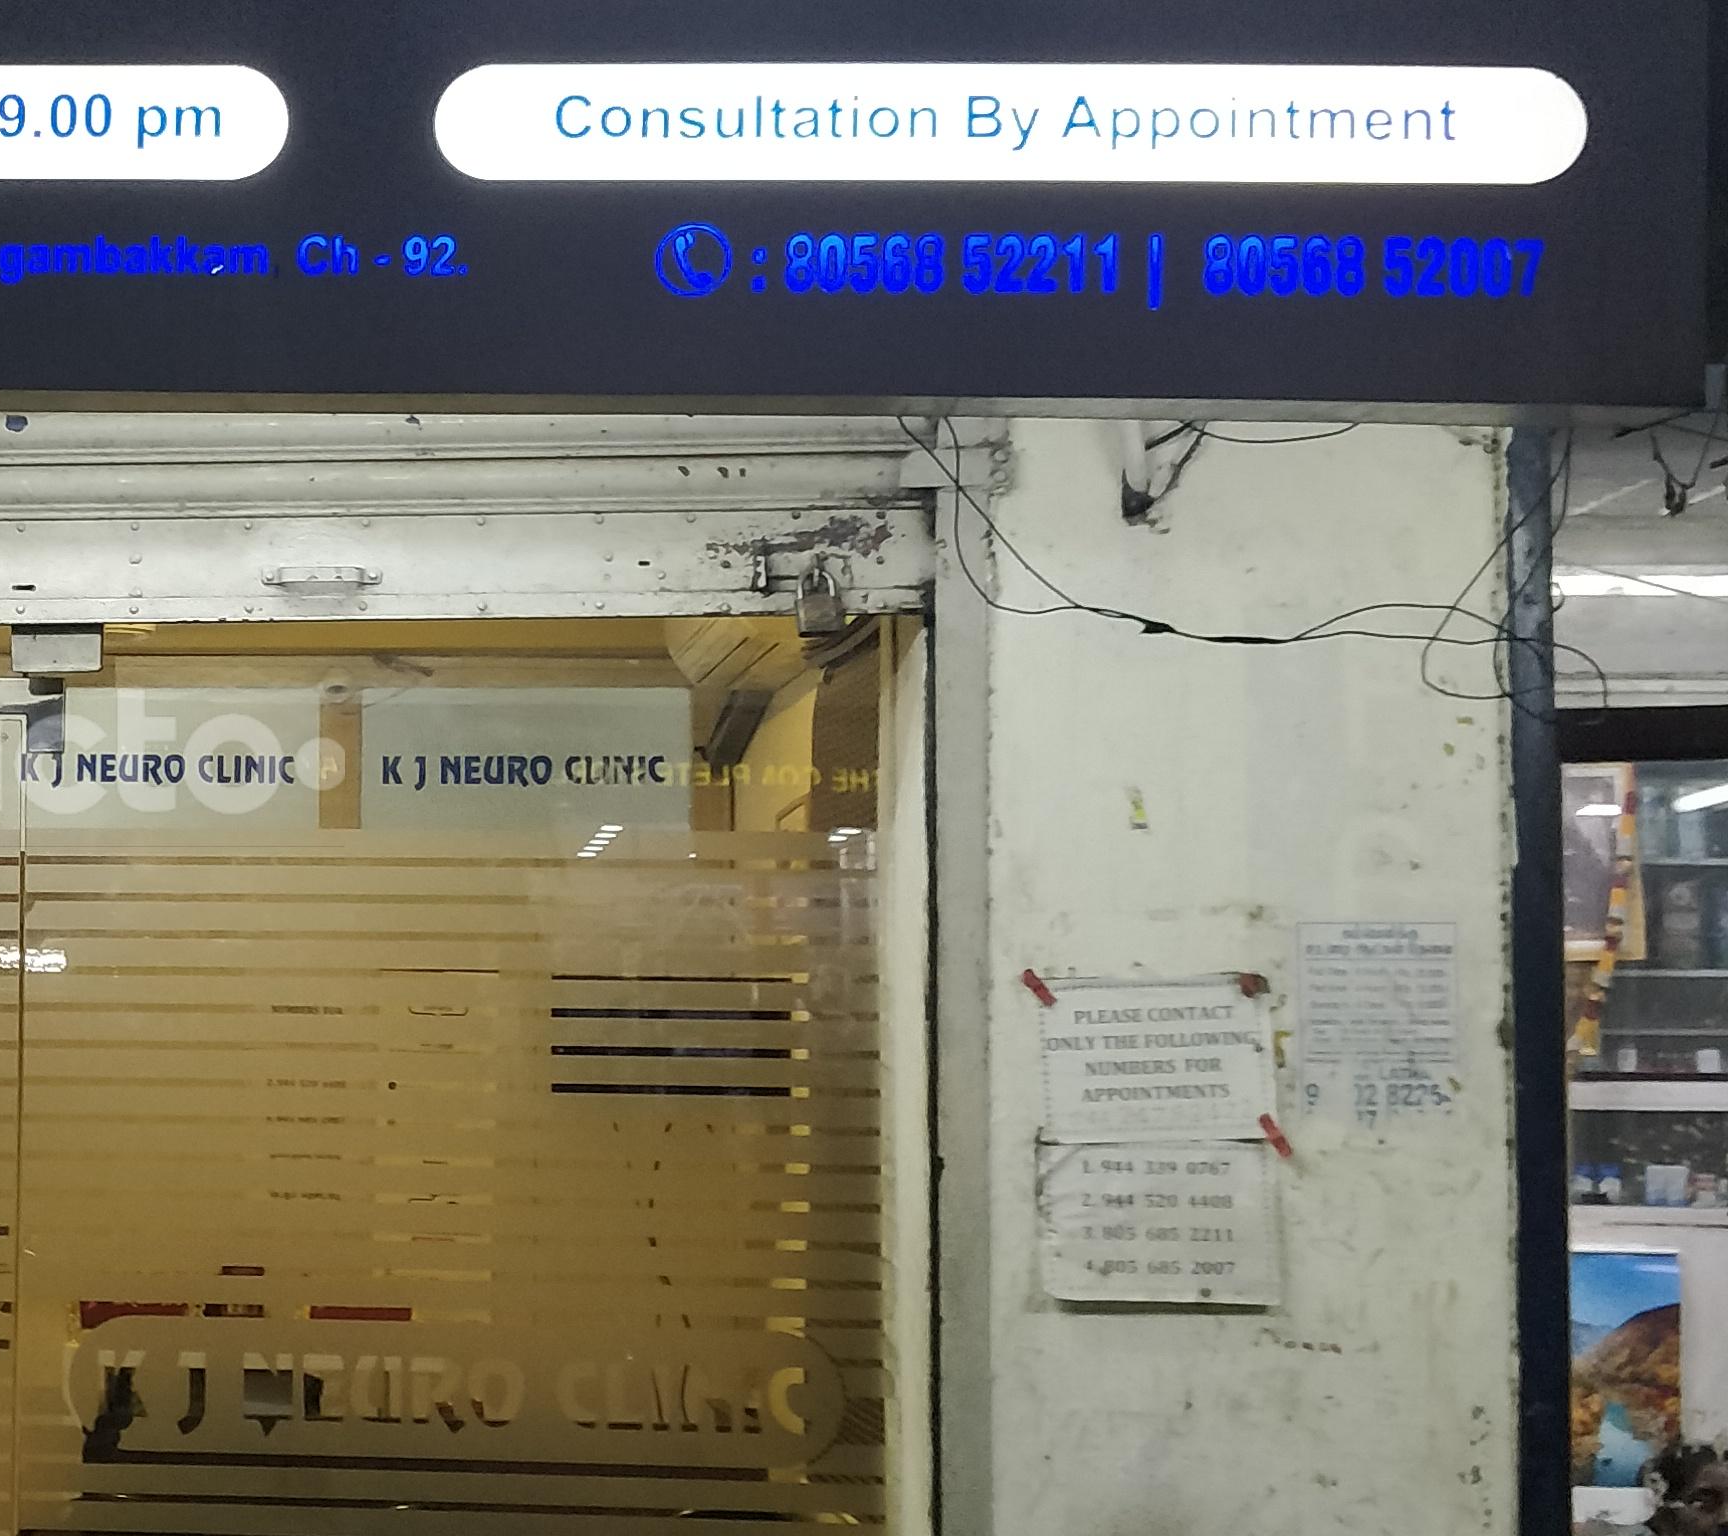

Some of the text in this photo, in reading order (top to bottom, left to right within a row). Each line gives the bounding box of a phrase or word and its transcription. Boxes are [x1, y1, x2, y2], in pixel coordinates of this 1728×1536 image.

[136, 101, 223, 149] pm
[554, 94, 1458, 152] Consultation By Appointment
[296, 233, 360, 275] Ch
[403, 233, 469, 277] 92.
[784, 231, 946, 296] 80568
[962, 231, 1120, 296] 52211
[1203, 232, 1367, 298] 80568
[1382, 235, 1547, 299] 52007
[76, 752, 186, 785] NEURO
[198, 754, 295, 785] CLINIC
[382, 754, 403, 785] K
[414, 754, 430, 791] J
[439, 754, 553, 788] NEURO
[1073, 1005, 1234, 1025] PLEASE CONTACT
[1046, 1031, 1257, 1051] ONLY THE FOLLOWING
[1084, 1057, 1223, 1076] NUMBERS FOR
[1081, 1083, 1231, 1103] APPOINTMENTS
